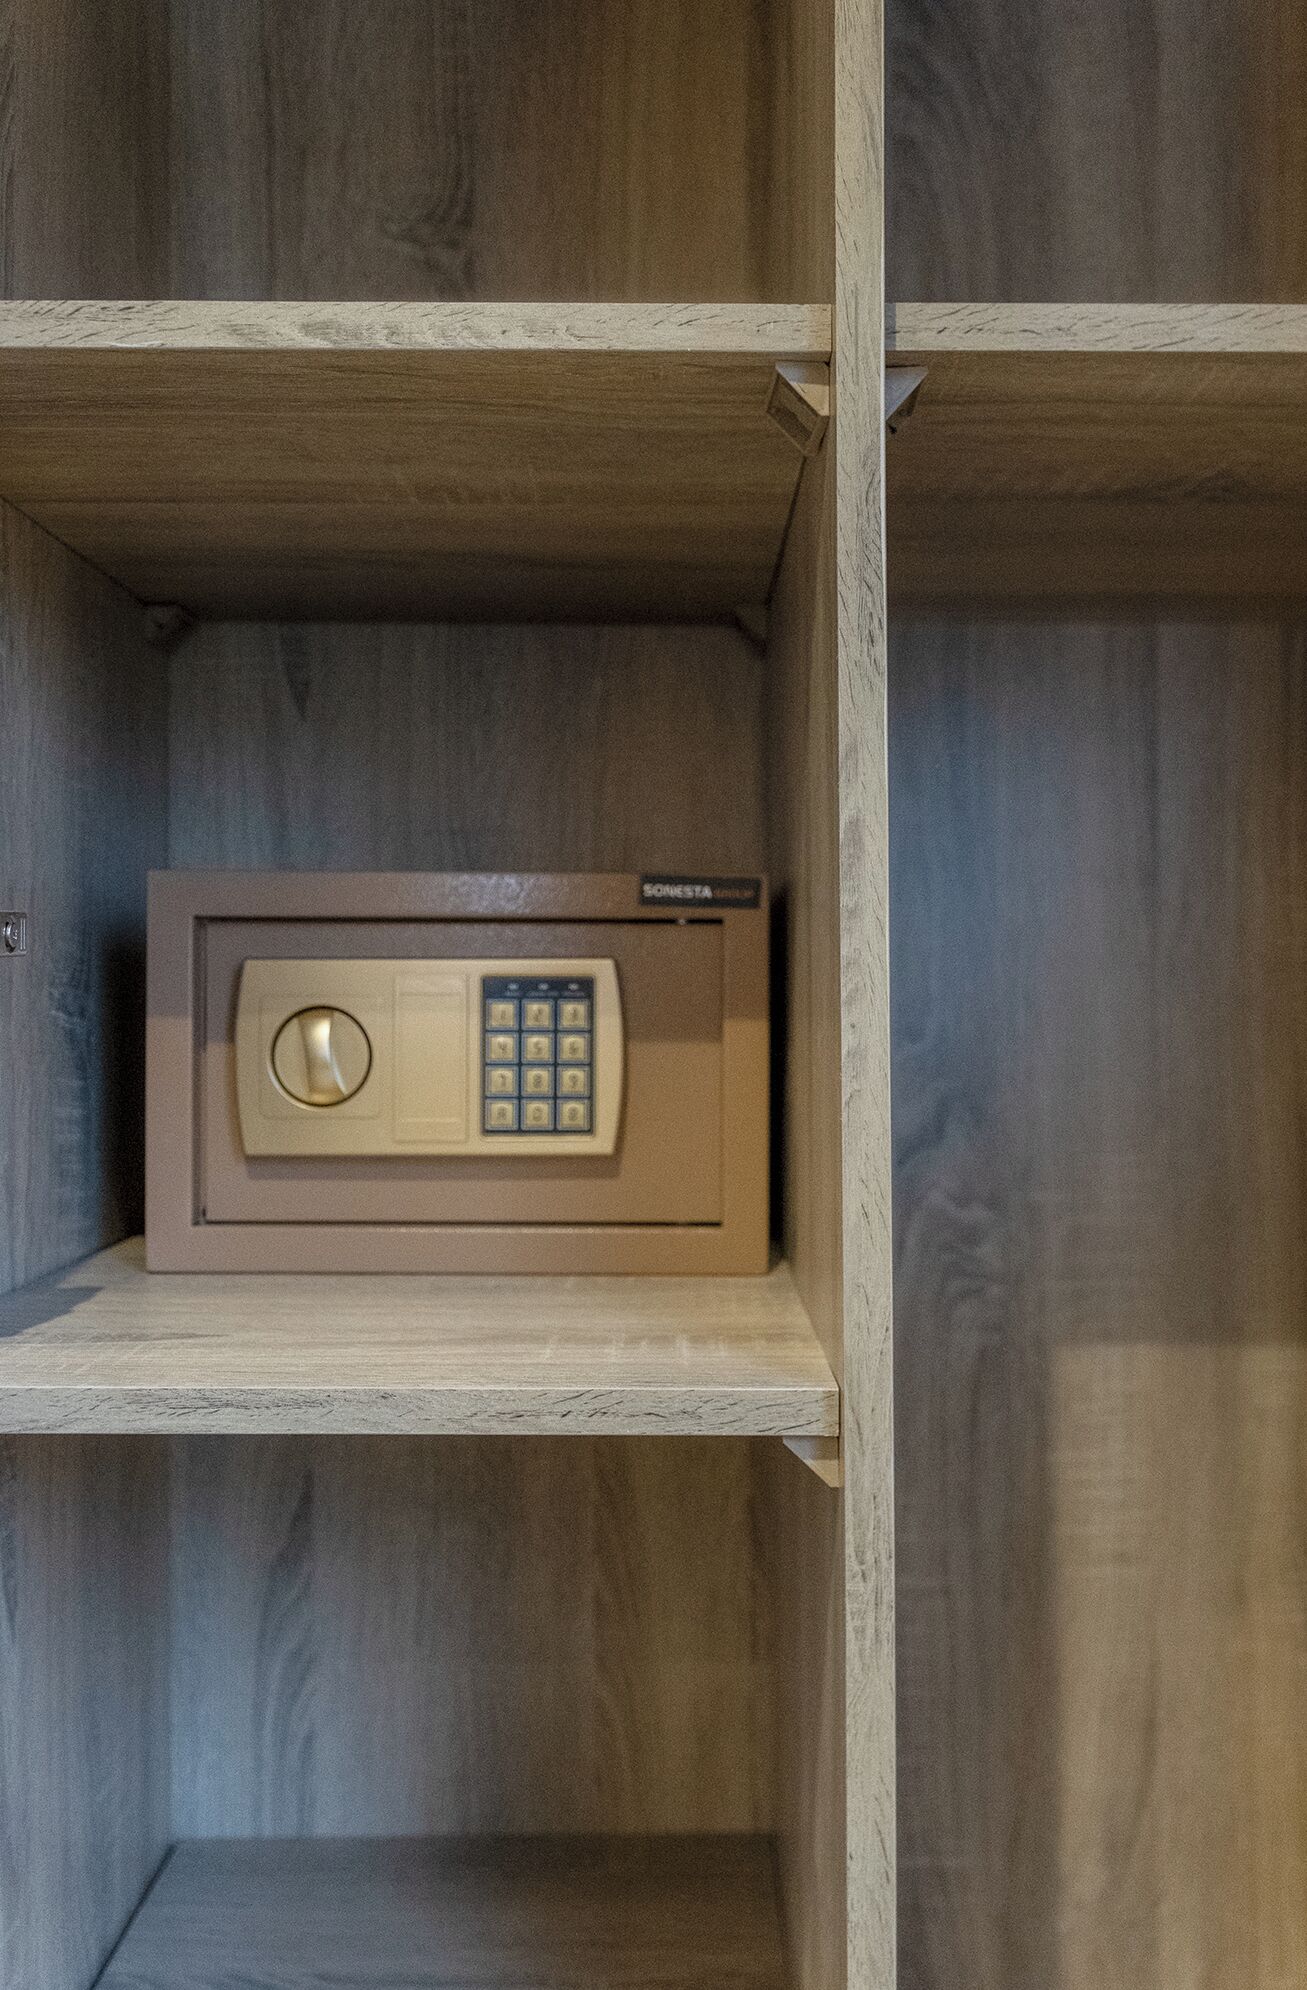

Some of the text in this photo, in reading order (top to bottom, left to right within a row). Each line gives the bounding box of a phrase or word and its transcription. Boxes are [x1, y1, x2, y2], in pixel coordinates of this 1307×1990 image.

[643, 883, 713, 899] SONESTA
[497, 1040, 579, 1056] 4 5 6
[532, 1072, 543, 1089] 8
[568, 1072, 579, 1089] 9
